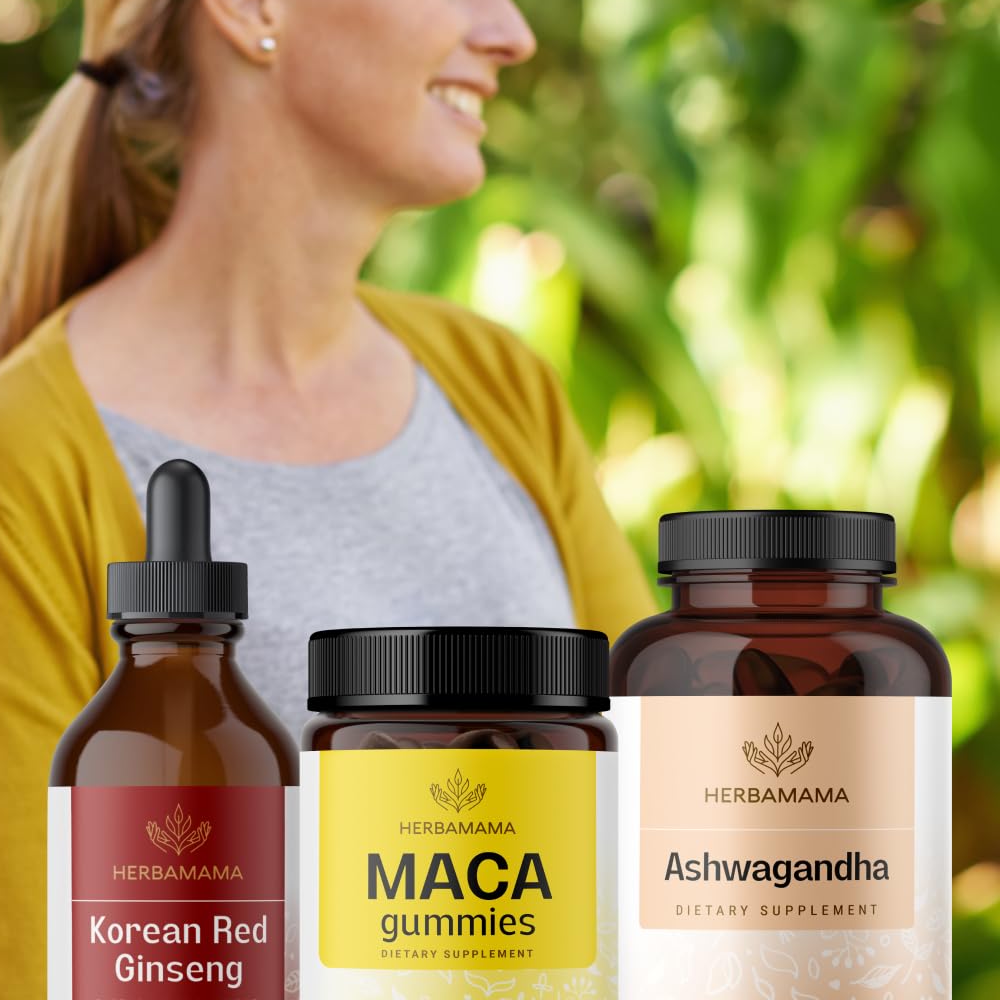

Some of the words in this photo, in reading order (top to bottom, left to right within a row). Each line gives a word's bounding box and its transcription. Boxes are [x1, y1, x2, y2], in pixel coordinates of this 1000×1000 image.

[704, 787, 850, 803] HERBAMAMA
[399, 821, 516, 835] HERBAMAMA
[113, 865, 244, 881] HERBAMAMA
[367, 851, 553, 900] MACA
[664, 851, 890, 888] Ashwagandha
[676, 904, 749, 916] DIETARY
[760, 903, 878, 916] SUPPLEMENT
[90, 915, 201, 944] Korean
[213, 914, 267, 944] Red
[381, 907, 536, 943] gummies
[381, 949, 437, 959] DIETARY
[443, 948, 534, 959] SUPPLEMENT
[114, 953, 243, 989] Ginseng
